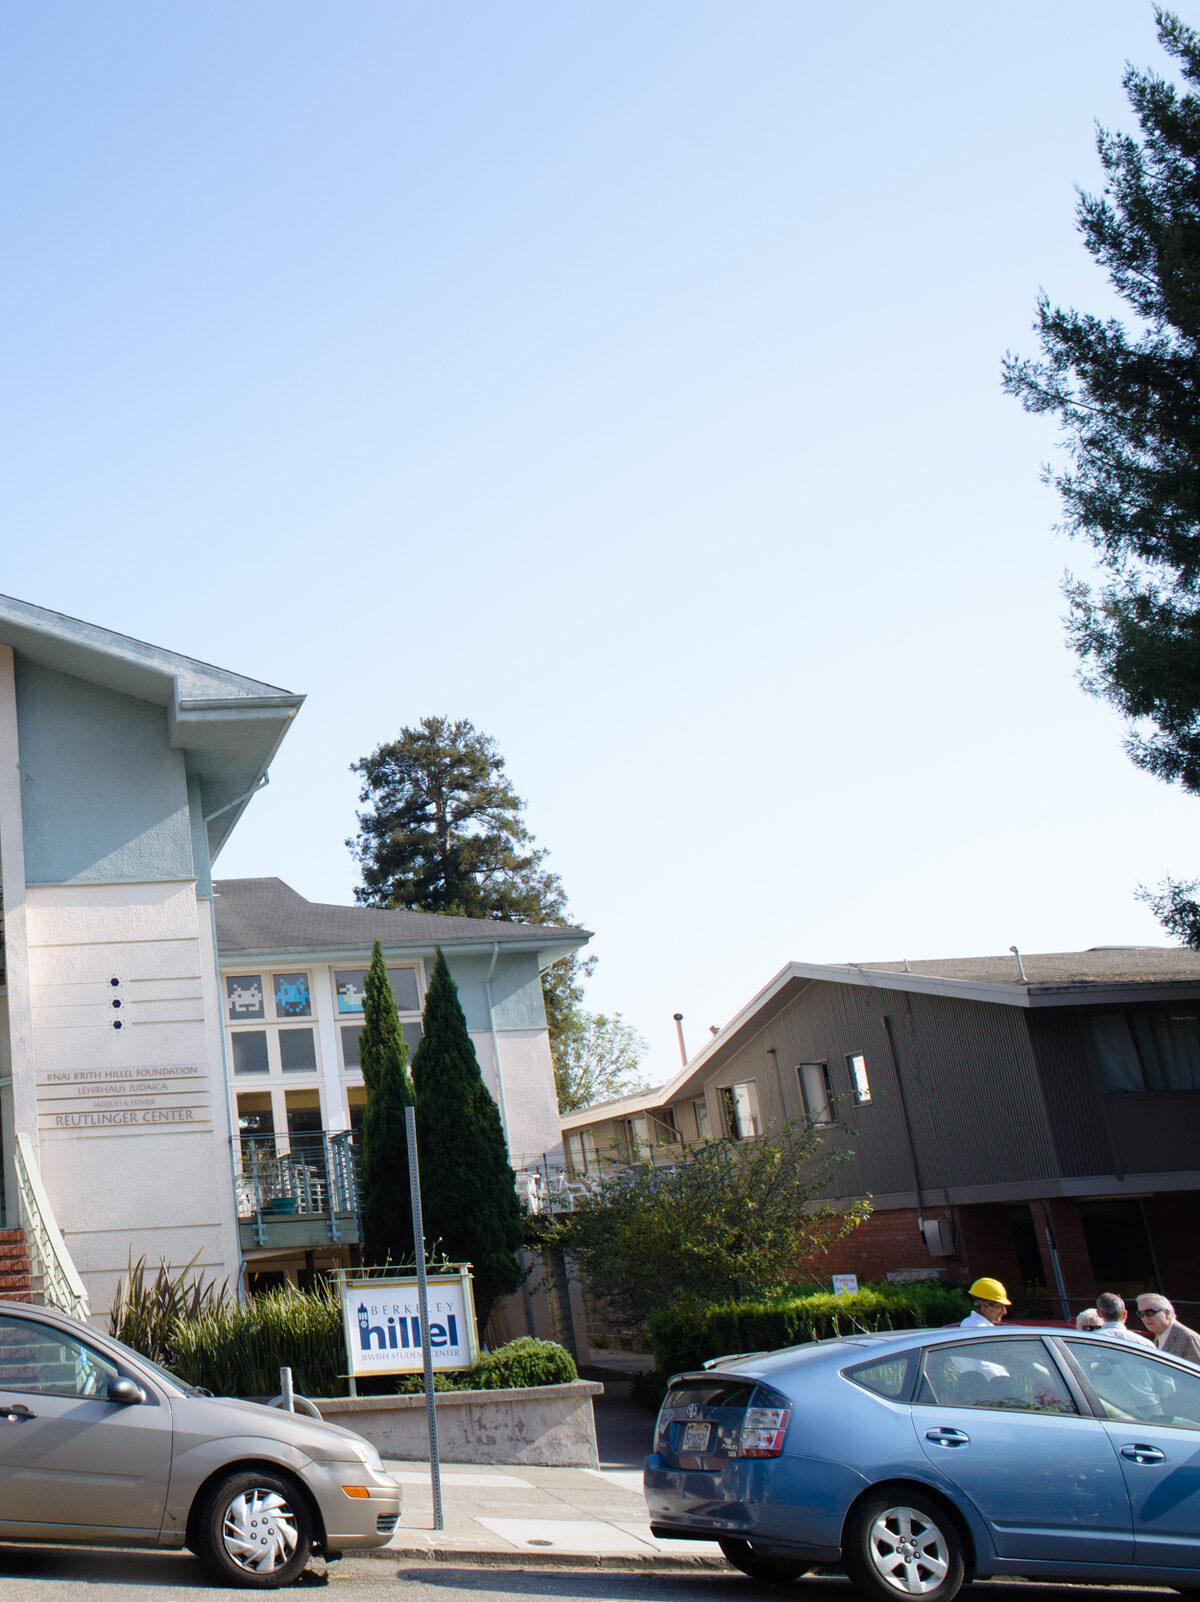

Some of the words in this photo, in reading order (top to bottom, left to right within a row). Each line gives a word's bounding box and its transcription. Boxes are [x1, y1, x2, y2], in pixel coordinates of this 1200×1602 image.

[104, 1068, 134, 1078] HILLEL
[135, 1066, 198, 1077] FOUNDATION
[77, 1084, 127, 1095] LEHRHAUS
[128, 1082, 168, 1092] JUDAICA
[55, 1112, 137, 1127] REUTLINGER
[142, 1109, 194, 1122] CENTER
[358, 1314, 459, 1350] hillel
[361, 1353, 390, 1361] JEWISH
[391, 1351, 426, 1360] STUDEN
